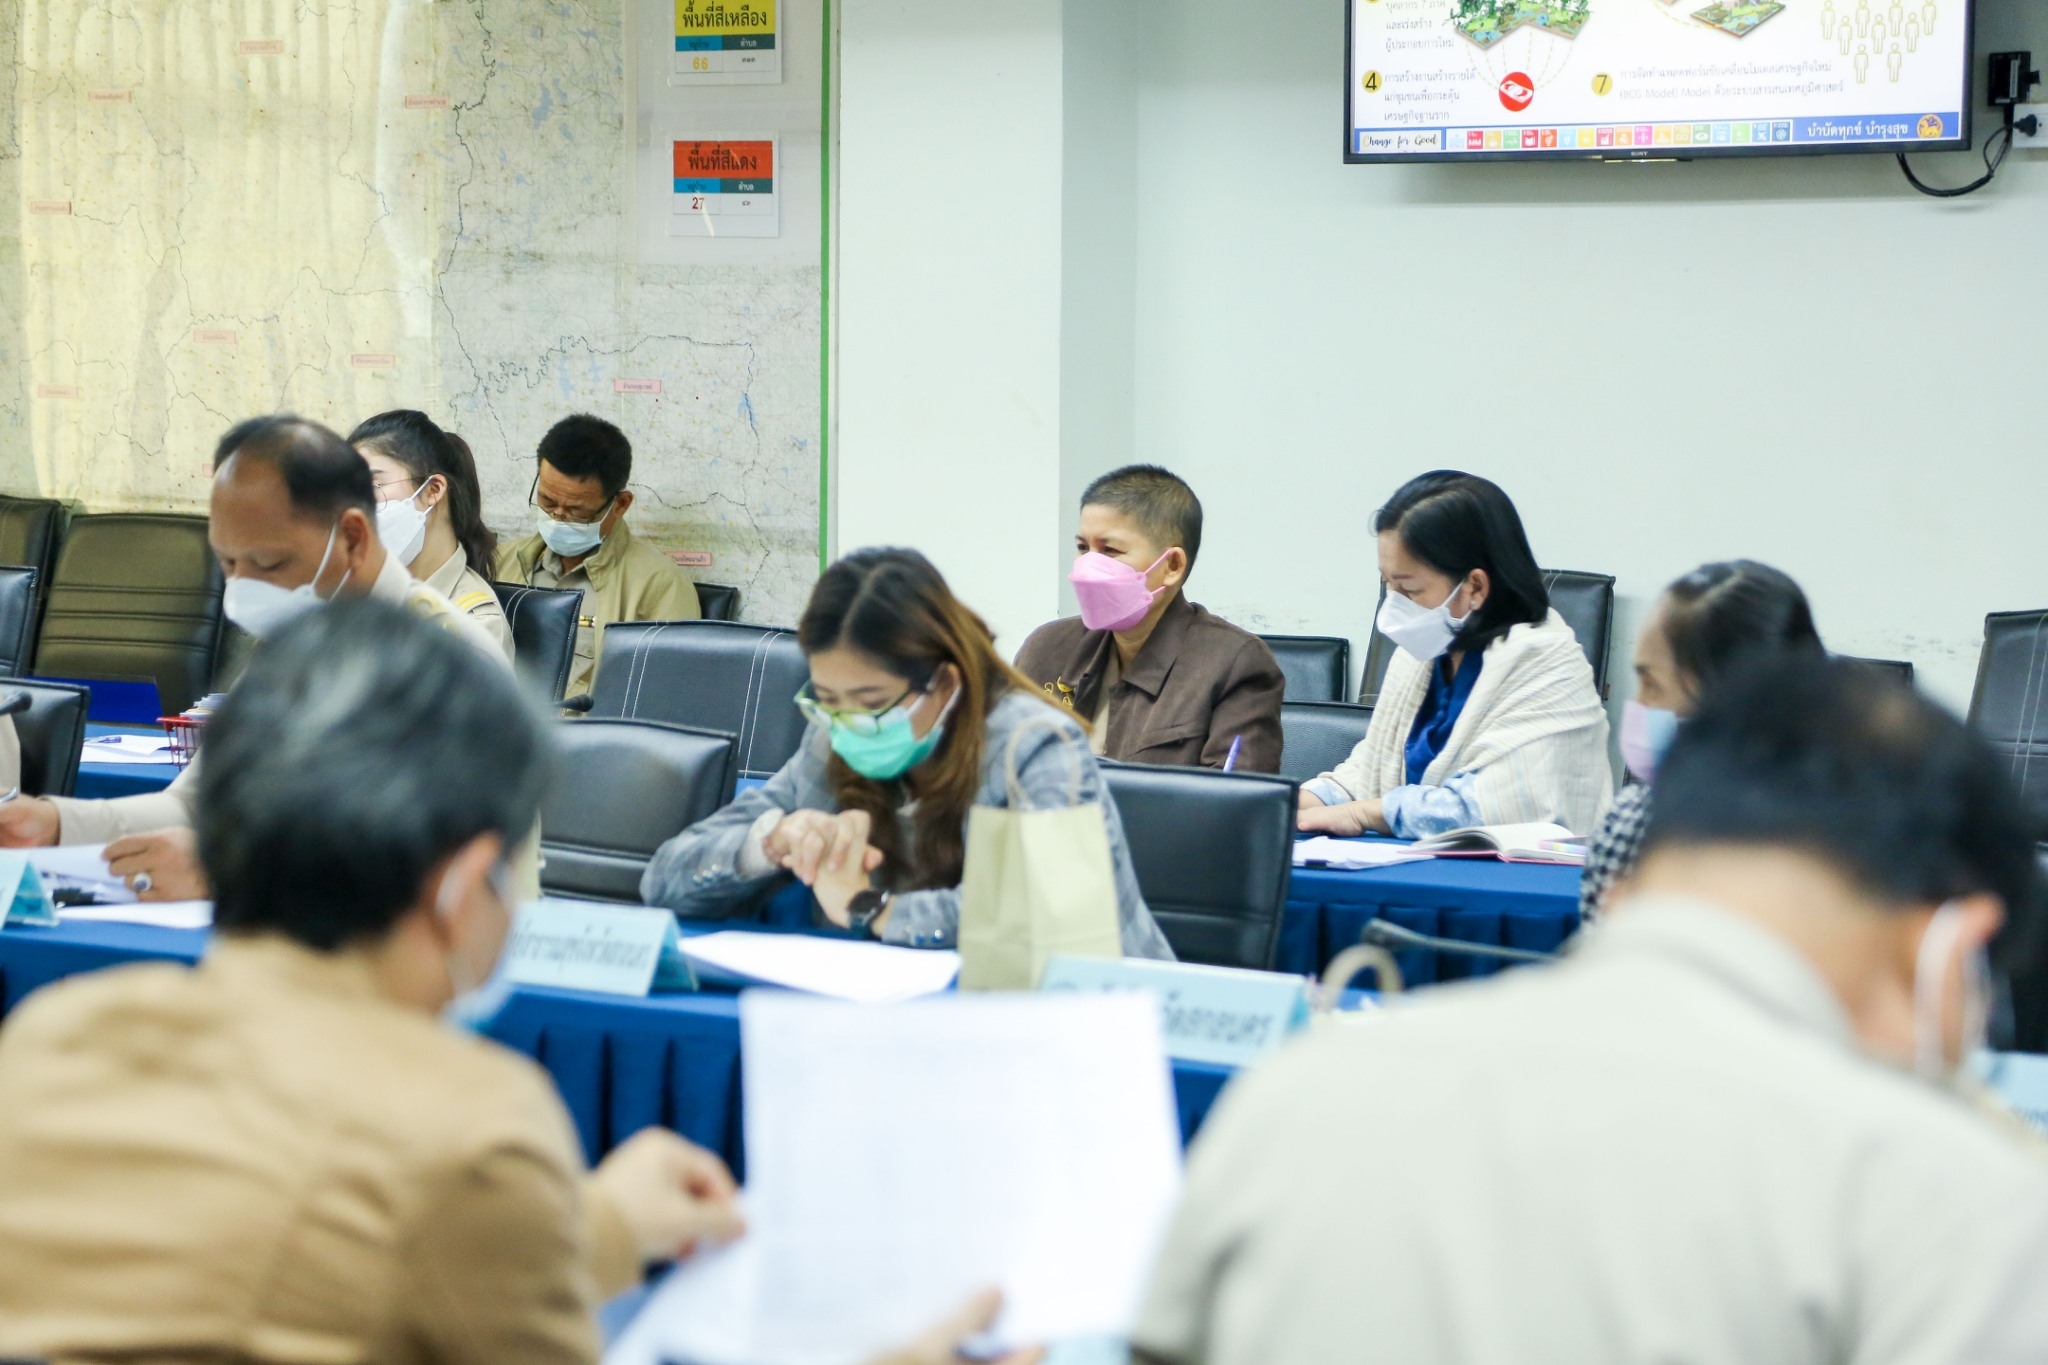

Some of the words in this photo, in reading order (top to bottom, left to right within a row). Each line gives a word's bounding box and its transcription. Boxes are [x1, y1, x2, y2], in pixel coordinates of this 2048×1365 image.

[682, 0, 768, 28] พื้นที่สีเหลือง
[740, 37, 757, 48] ตำบล
[693, 56, 709, 71] 66
[1365, 72, 1378, 91] 4
[1595, 74, 1608, 93] 7
[1807, 121, 1863, 140] บำบัดทุกข์
[1866, 120, 1908, 139] บำรุงสุข
[1397, 135, 1410, 149] for
[1414, 134, 1437, 146] Good
[688, 143, 758, 171] พื้นที่สีแดง
[738, 181, 754, 192] ตำบล
[692, 197, 705, 210] 27
